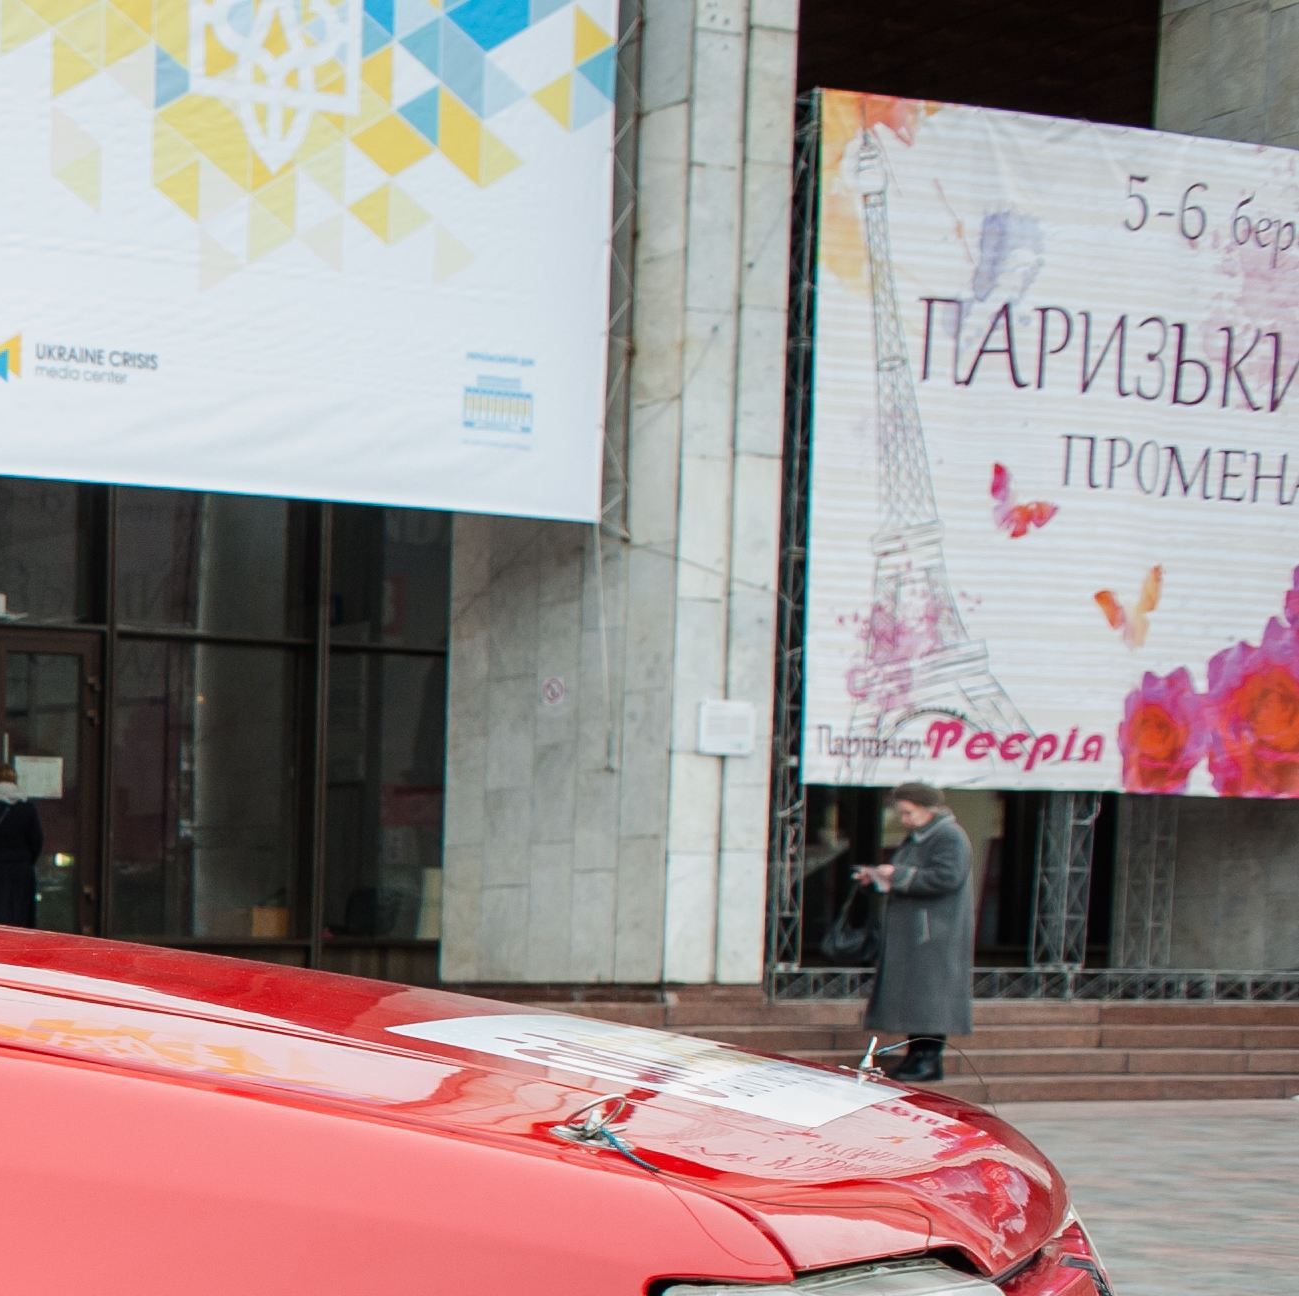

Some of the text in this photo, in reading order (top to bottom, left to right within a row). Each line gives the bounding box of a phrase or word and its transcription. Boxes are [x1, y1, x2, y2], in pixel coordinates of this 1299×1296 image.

[1124, 175, 1295, 268] 5-6 бер
[35, 344, 159, 371] UKRAINE CRISIS
[35, 365, 128, 385] media center
